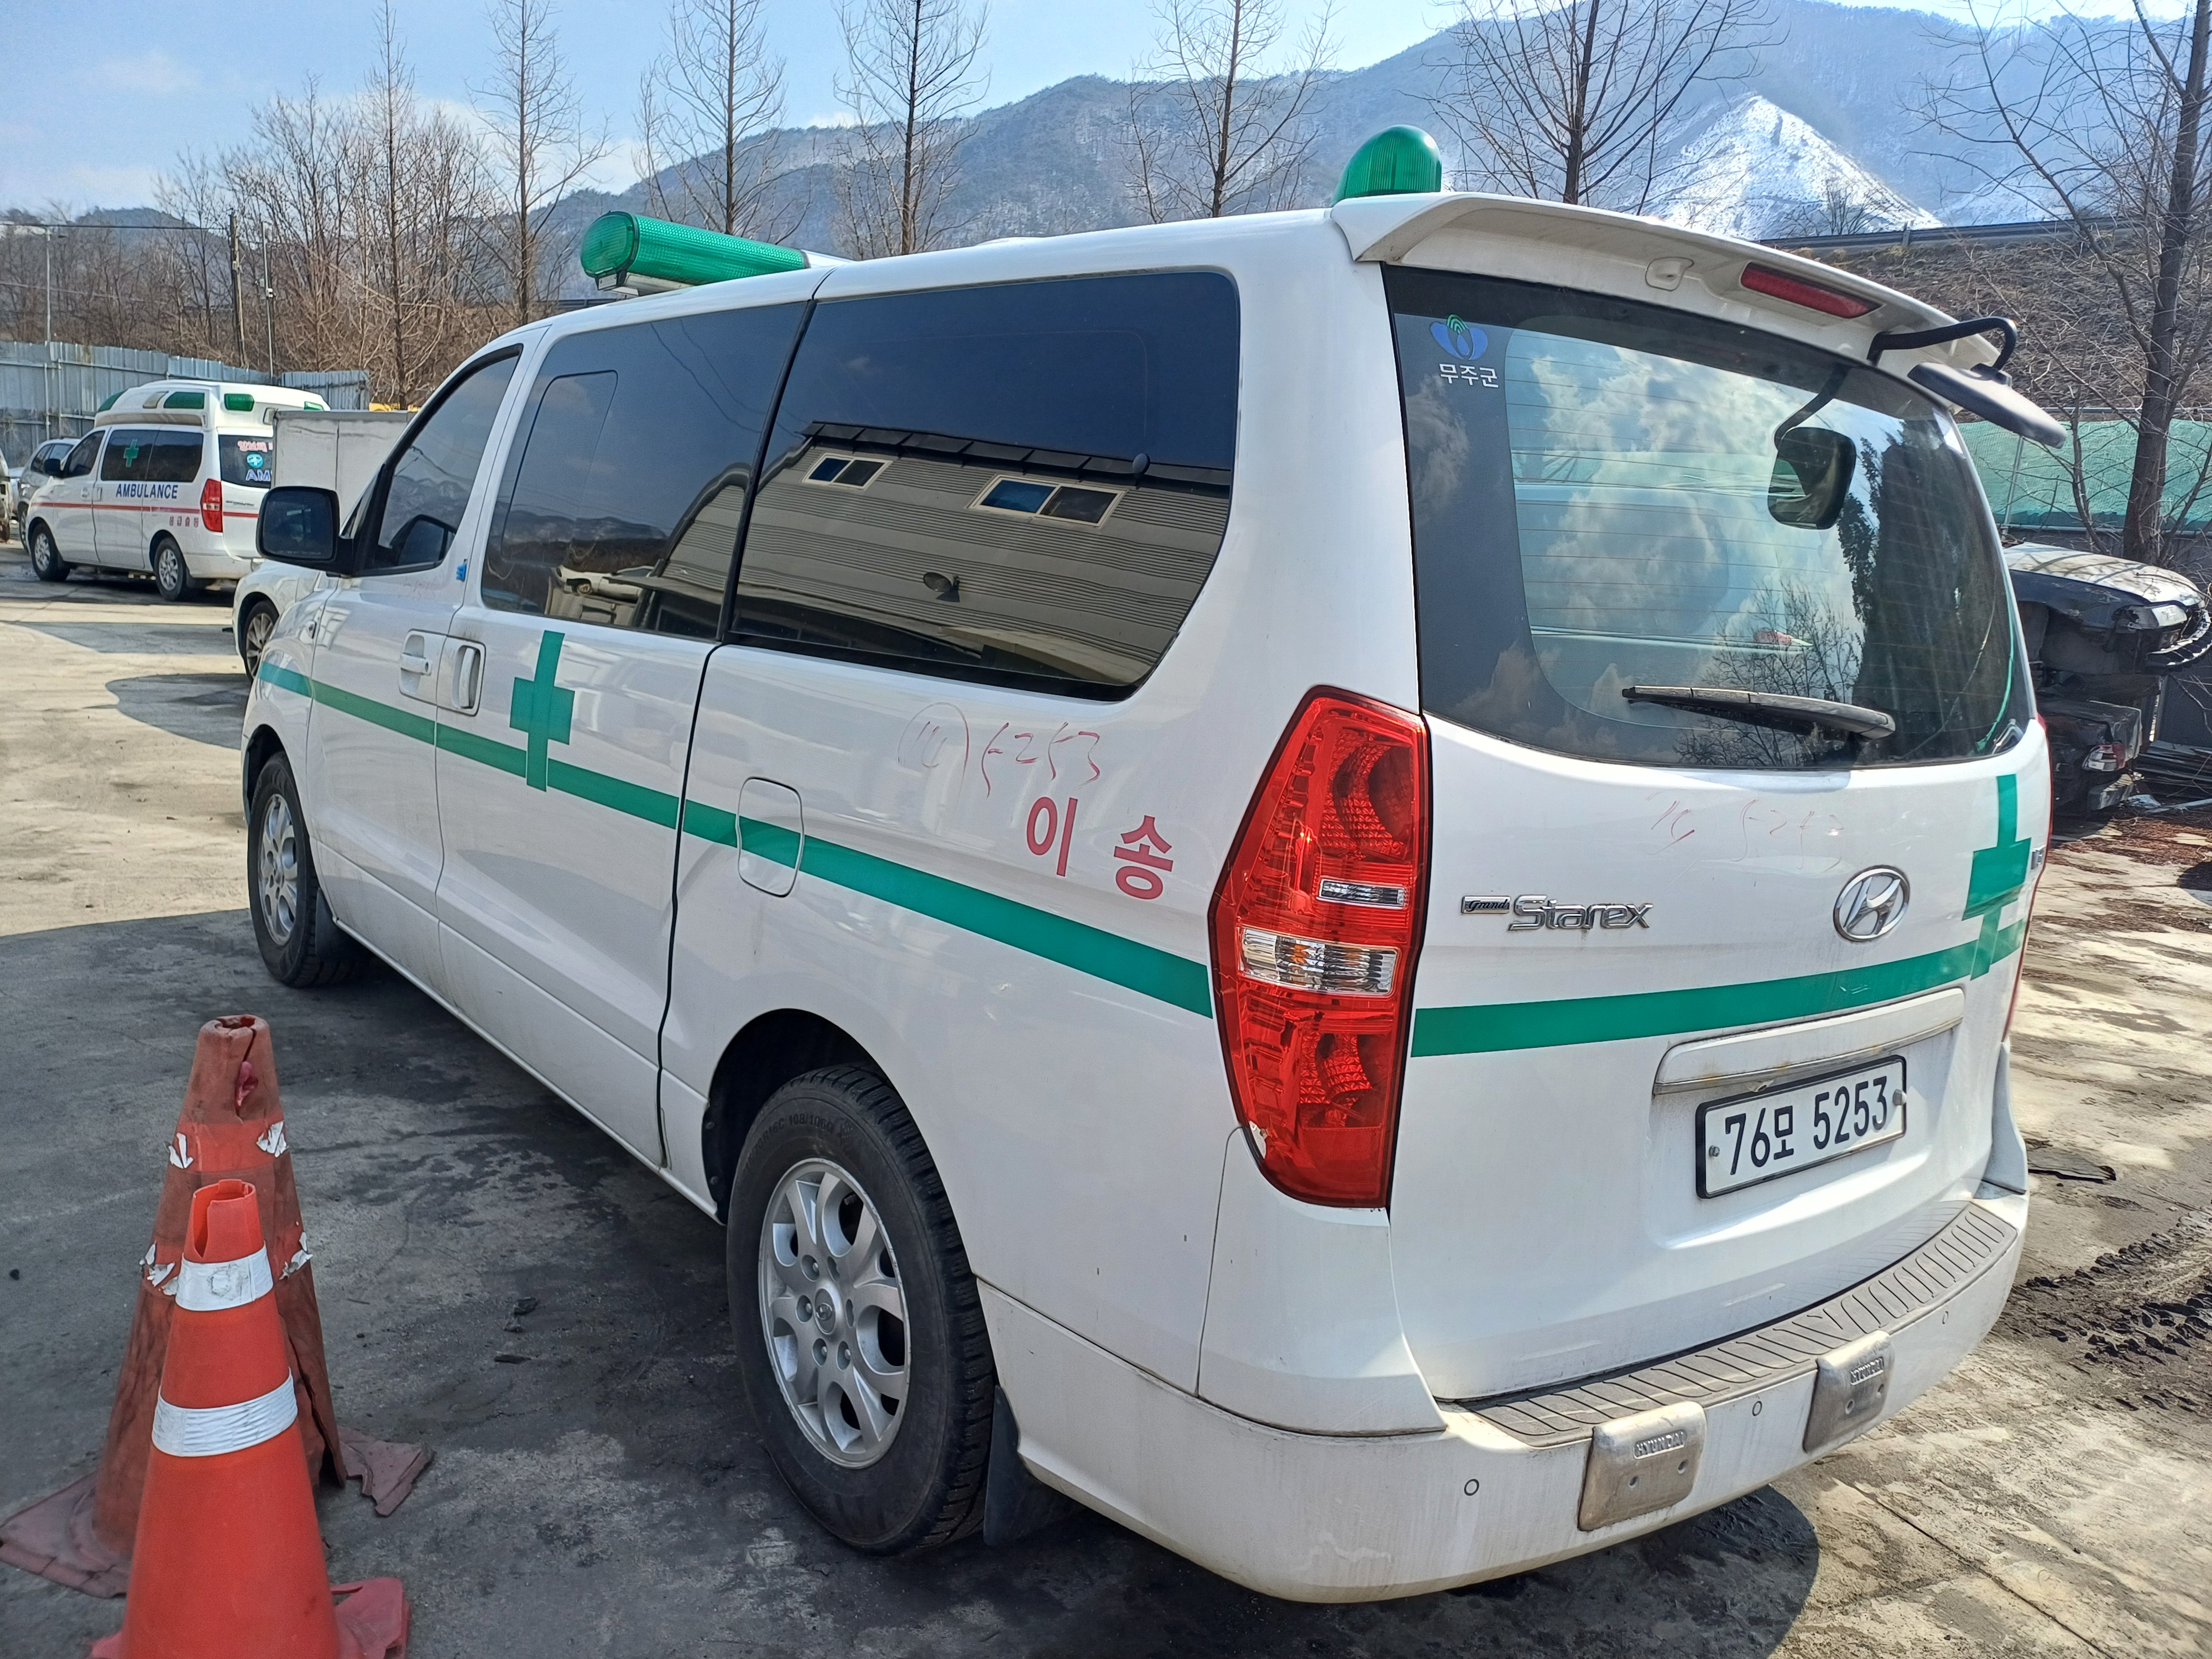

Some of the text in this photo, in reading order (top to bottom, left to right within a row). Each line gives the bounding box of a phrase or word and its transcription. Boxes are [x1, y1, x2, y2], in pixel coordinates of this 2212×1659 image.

[1439, 363, 1499, 388] 무주군
[116, 483, 179, 499] AMBULANCE
[1467, 894, 1654, 931] Grand Starex
[1725, 1075, 1887, 1176] 76모 5253
[1635, 1431, 1686, 1458] HYUNDAI
